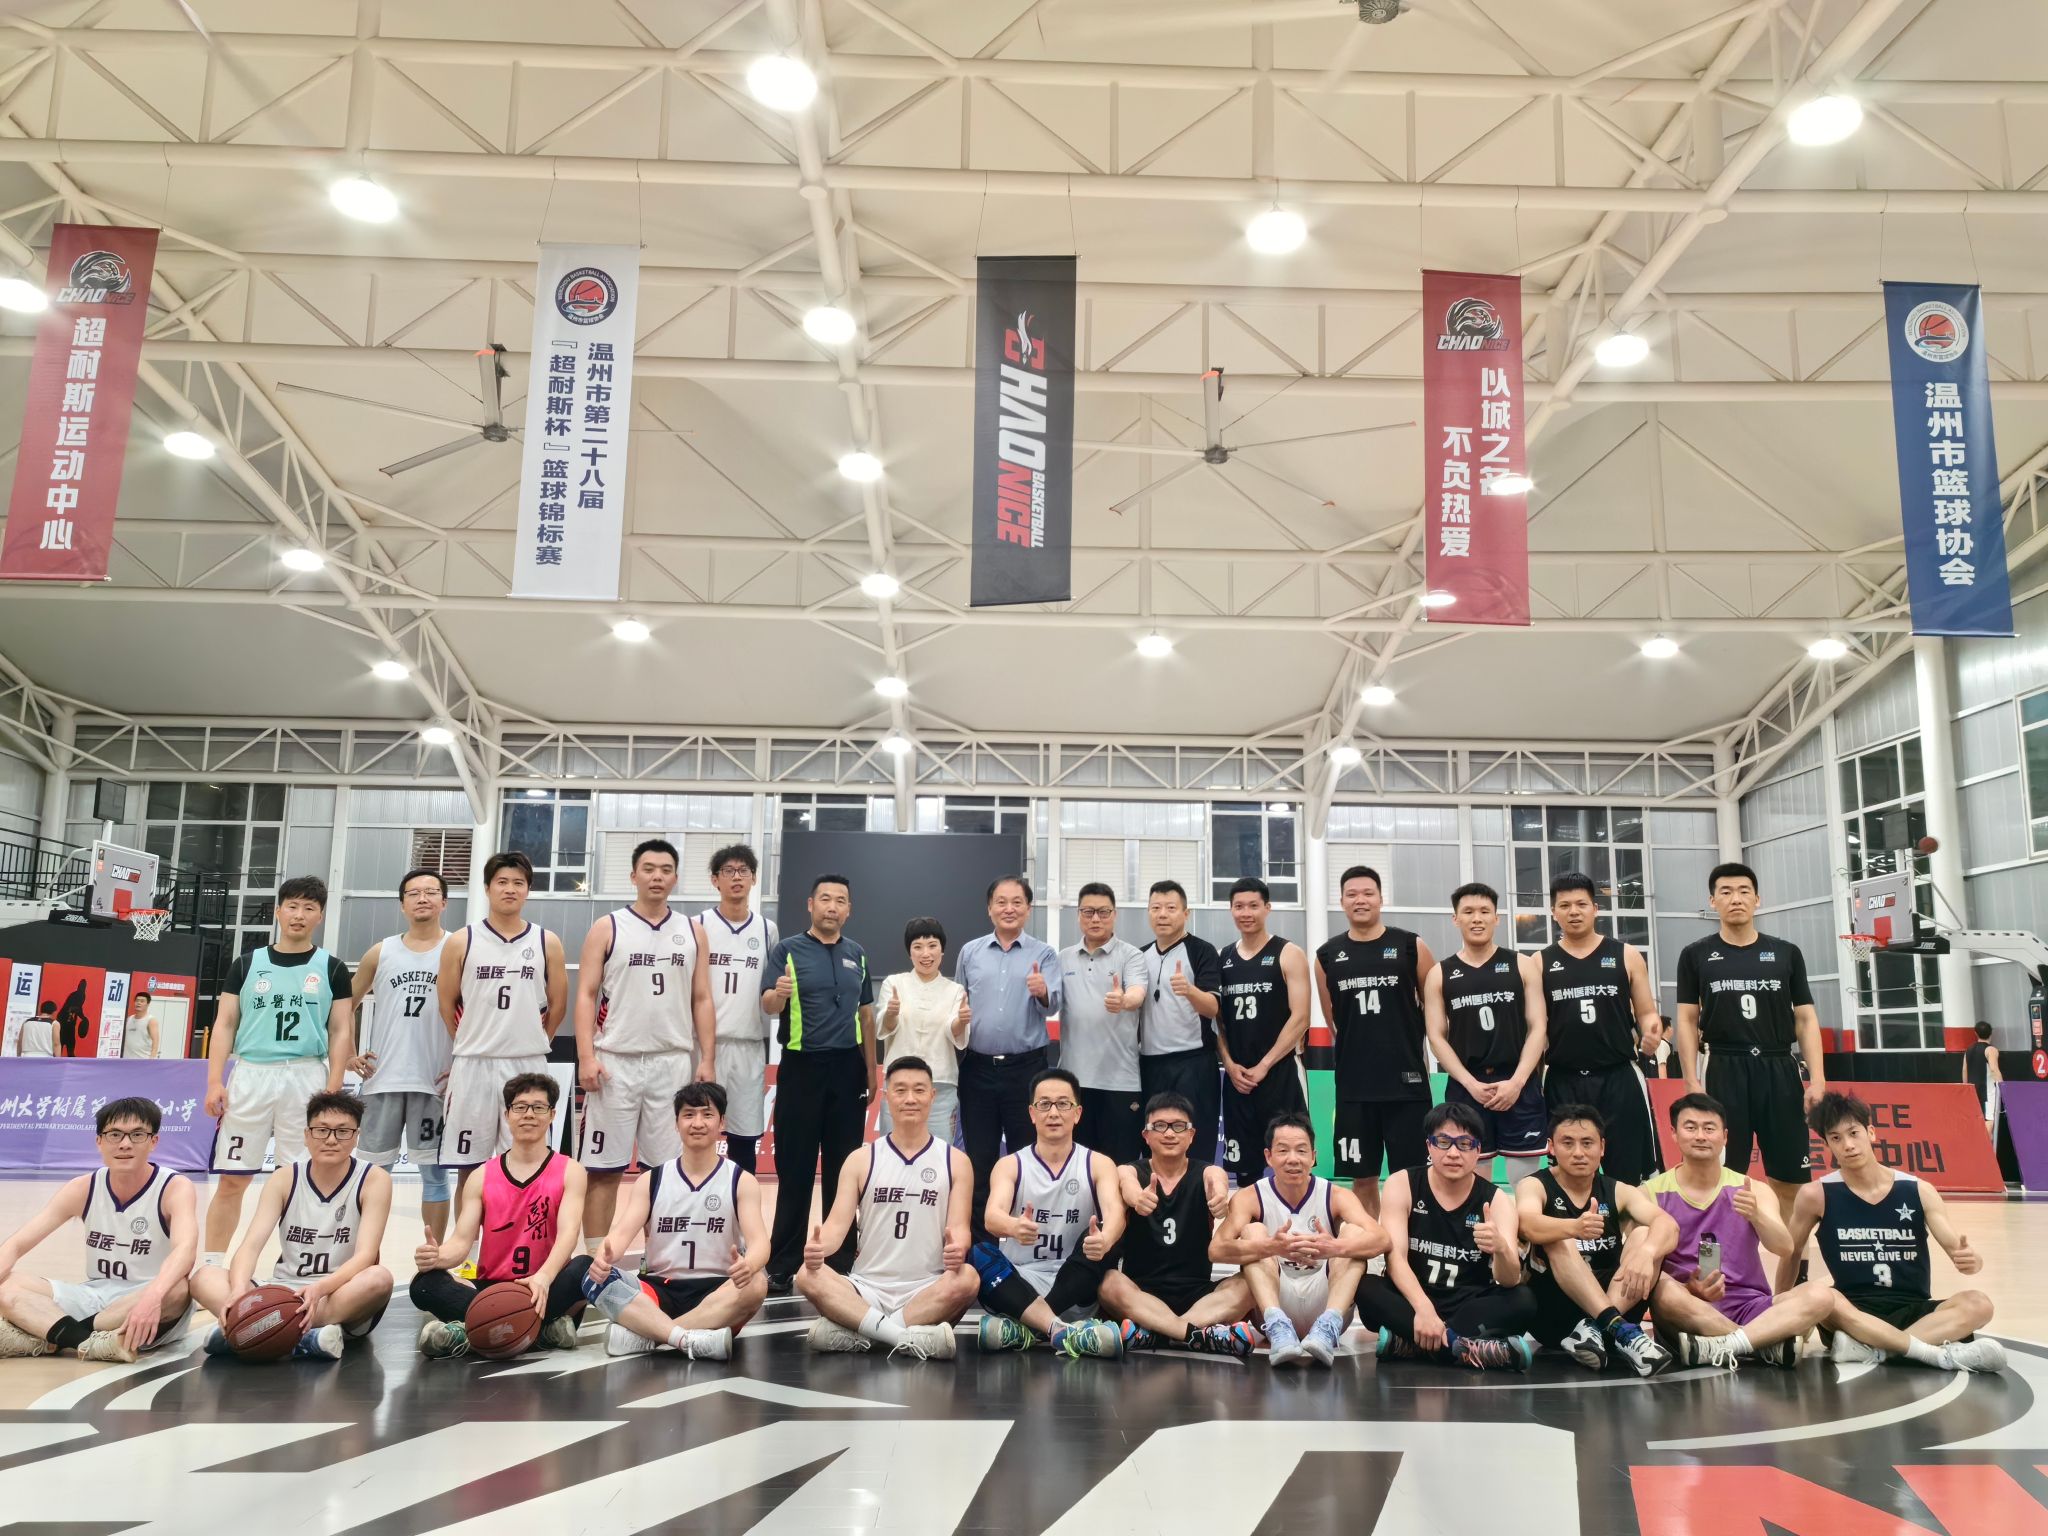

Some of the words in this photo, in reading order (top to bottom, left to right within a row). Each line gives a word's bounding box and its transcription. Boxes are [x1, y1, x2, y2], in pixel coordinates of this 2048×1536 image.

[40, 317, 107, 549] 超耐斯运动中心
[577, 342, 615, 509] 温州市第二十八届
[1440, 426, 1473, 557] 不负热爱
[1925, 382, 1976, 586] 温州市篮球协会
[1031, 470, 1046, 548] BASKETBALL
[628, 953, 685, 967] 温医一院
[15, 971, 34, 996] 运
[476, 965, 535, 980] 温医一院
[651, 972, 665, 996] 9
[724, 972, 738, 994] 11
[1337, 975, 1399, 992] 温州医科大学
[107, 979, 124, 1002] 动
[408, 984, 428, 994] CITY
[497, 985, 511, 1010] 6
[1551, 984, 1618, 1001] 温州医科大学
[1709, 979, 1782, 993] 温州医科大学
[403, 996, 426, 1017] 17
[1234, 996, 1257, 1020] 23
[1355, 989, 1381, 1015] 14
[1451, 990, 1515, 1010] 温州医科大学
[1580, 999, 1596, 1024] 5
[1740, 994, 1757, 1019] 9
[275, 1011, 300, 1041] 12
[1479, 1006, 1495, 1031] 0
[2036, 1053, 2046, 1074] 2
[227, 1136, 244, 1161] 2
[457, 1130, 472, 1154] 6
[590, 1130, 605, 1154] 9
[1338, 1137, 1362, 1163] 14
[873, 1187, 939, 1206] 温医一院
[657, 1216, 726, 1234] 温医一院
[894, 1211, 910, 1239] 8
[1021, 1206, 1080, 1224] 医一院
[285, 1225, 351, 1245] 温医一院
[1163, 1217, 1177, 1245] 3
[1837, 1228, 1916, 1241] BASKETBALL
[681, 1240, 696, 1270] 7
[1033, 1233, 1063, 1260] 24
[1840, 1251, 1875, 1261] NEVER
[1877, 1251, 1902, 1261] GIVE
[1903, 1251, 1918, 1260] UP
[297, 1252, 330, 1277] 20
[511, 1246, 531, 1275] 9
[1427, 1259, 1459, 1288] 77
